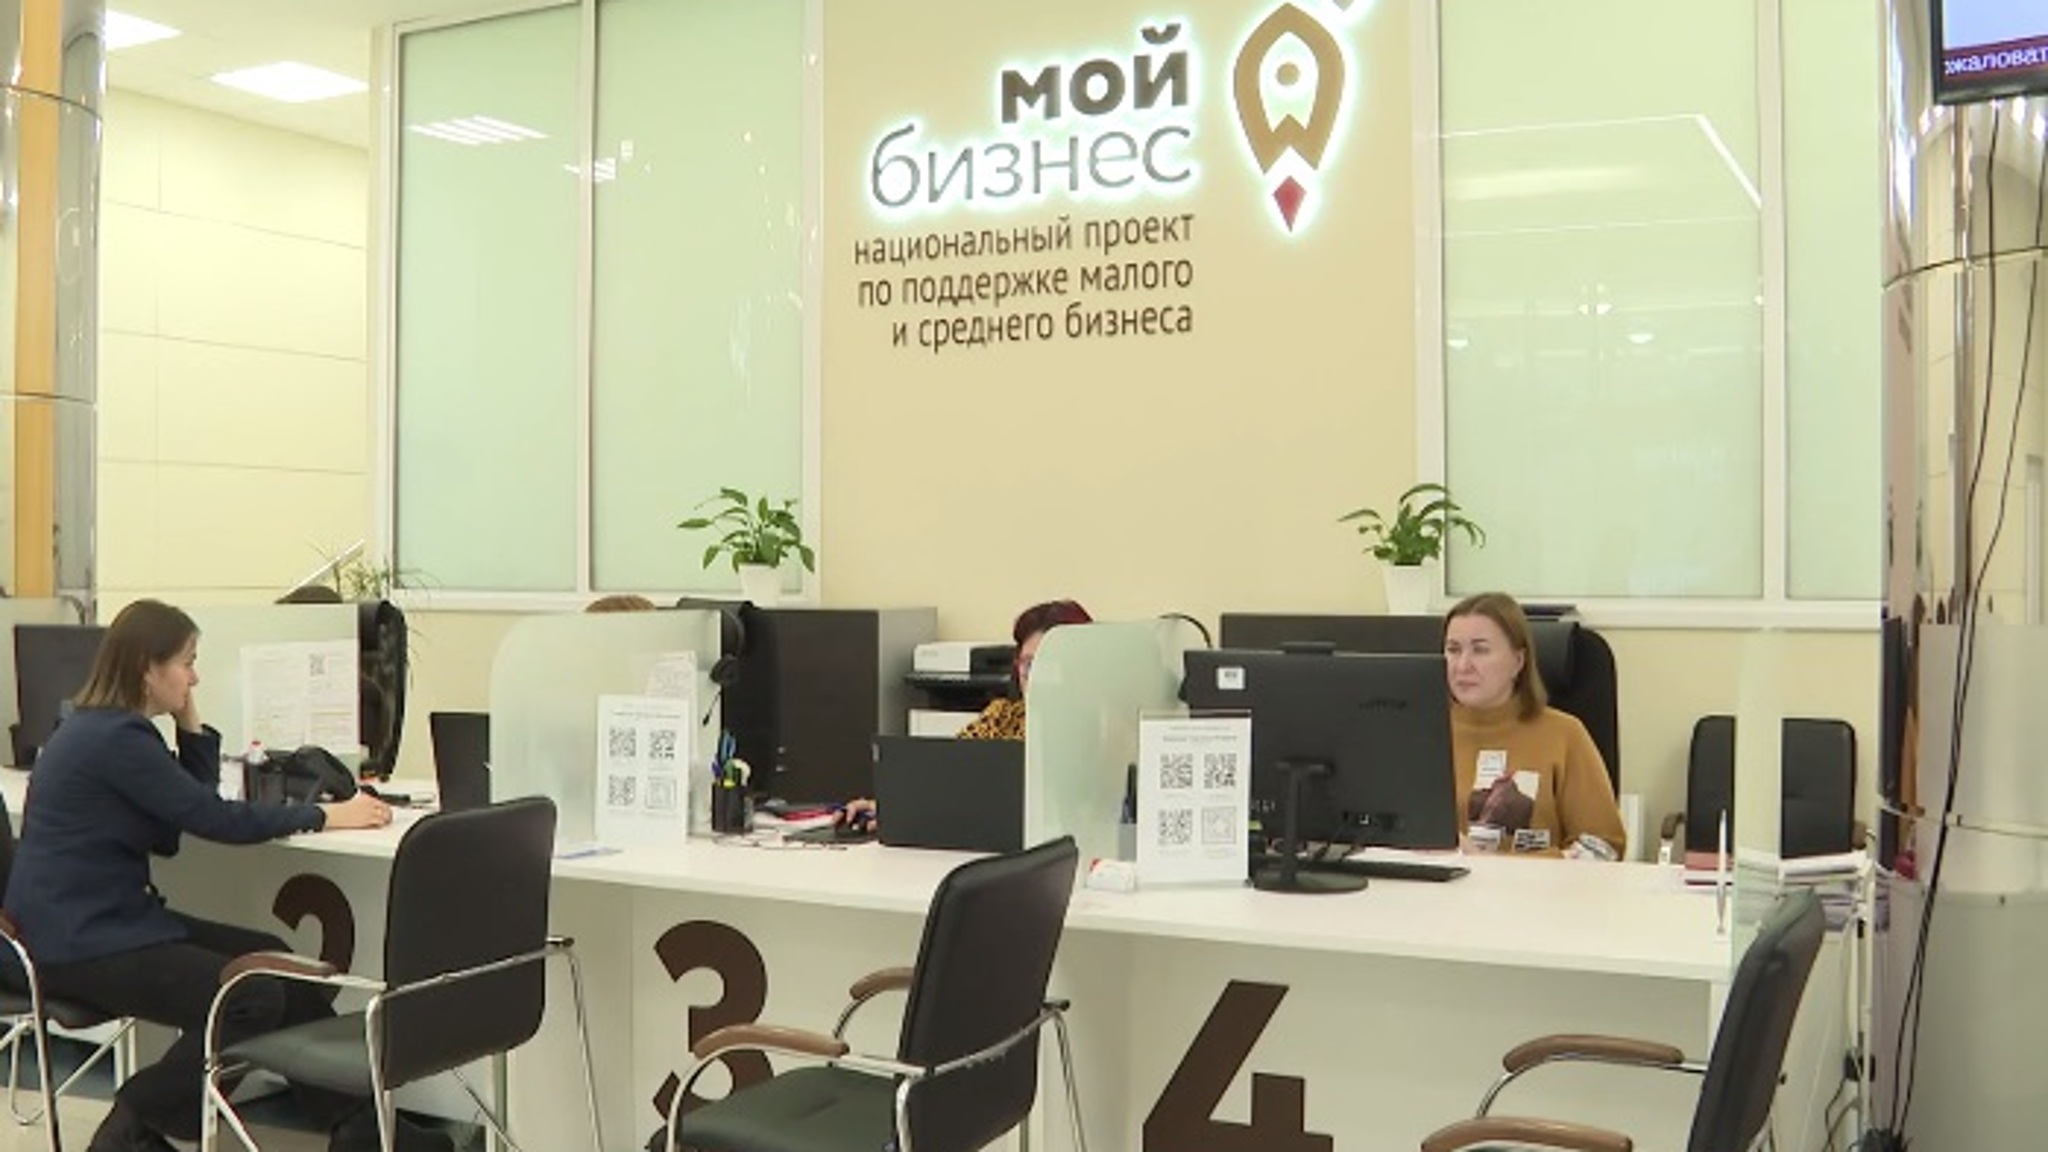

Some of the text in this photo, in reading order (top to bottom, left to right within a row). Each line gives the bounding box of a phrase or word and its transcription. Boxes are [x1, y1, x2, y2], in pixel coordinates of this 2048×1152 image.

[1002, 23, 1188, 123] мой
[871, 124, 1192, 207] бизнес
[854, 213, 1195, 267] национальный проект
[858, 259, 1194, 308] по поддержке малого
[892, 301, 1193, 355] и среднего бизнеса
[653, 919, 774, 1121] 3
[1142, 979, 1334, 1152] 4
